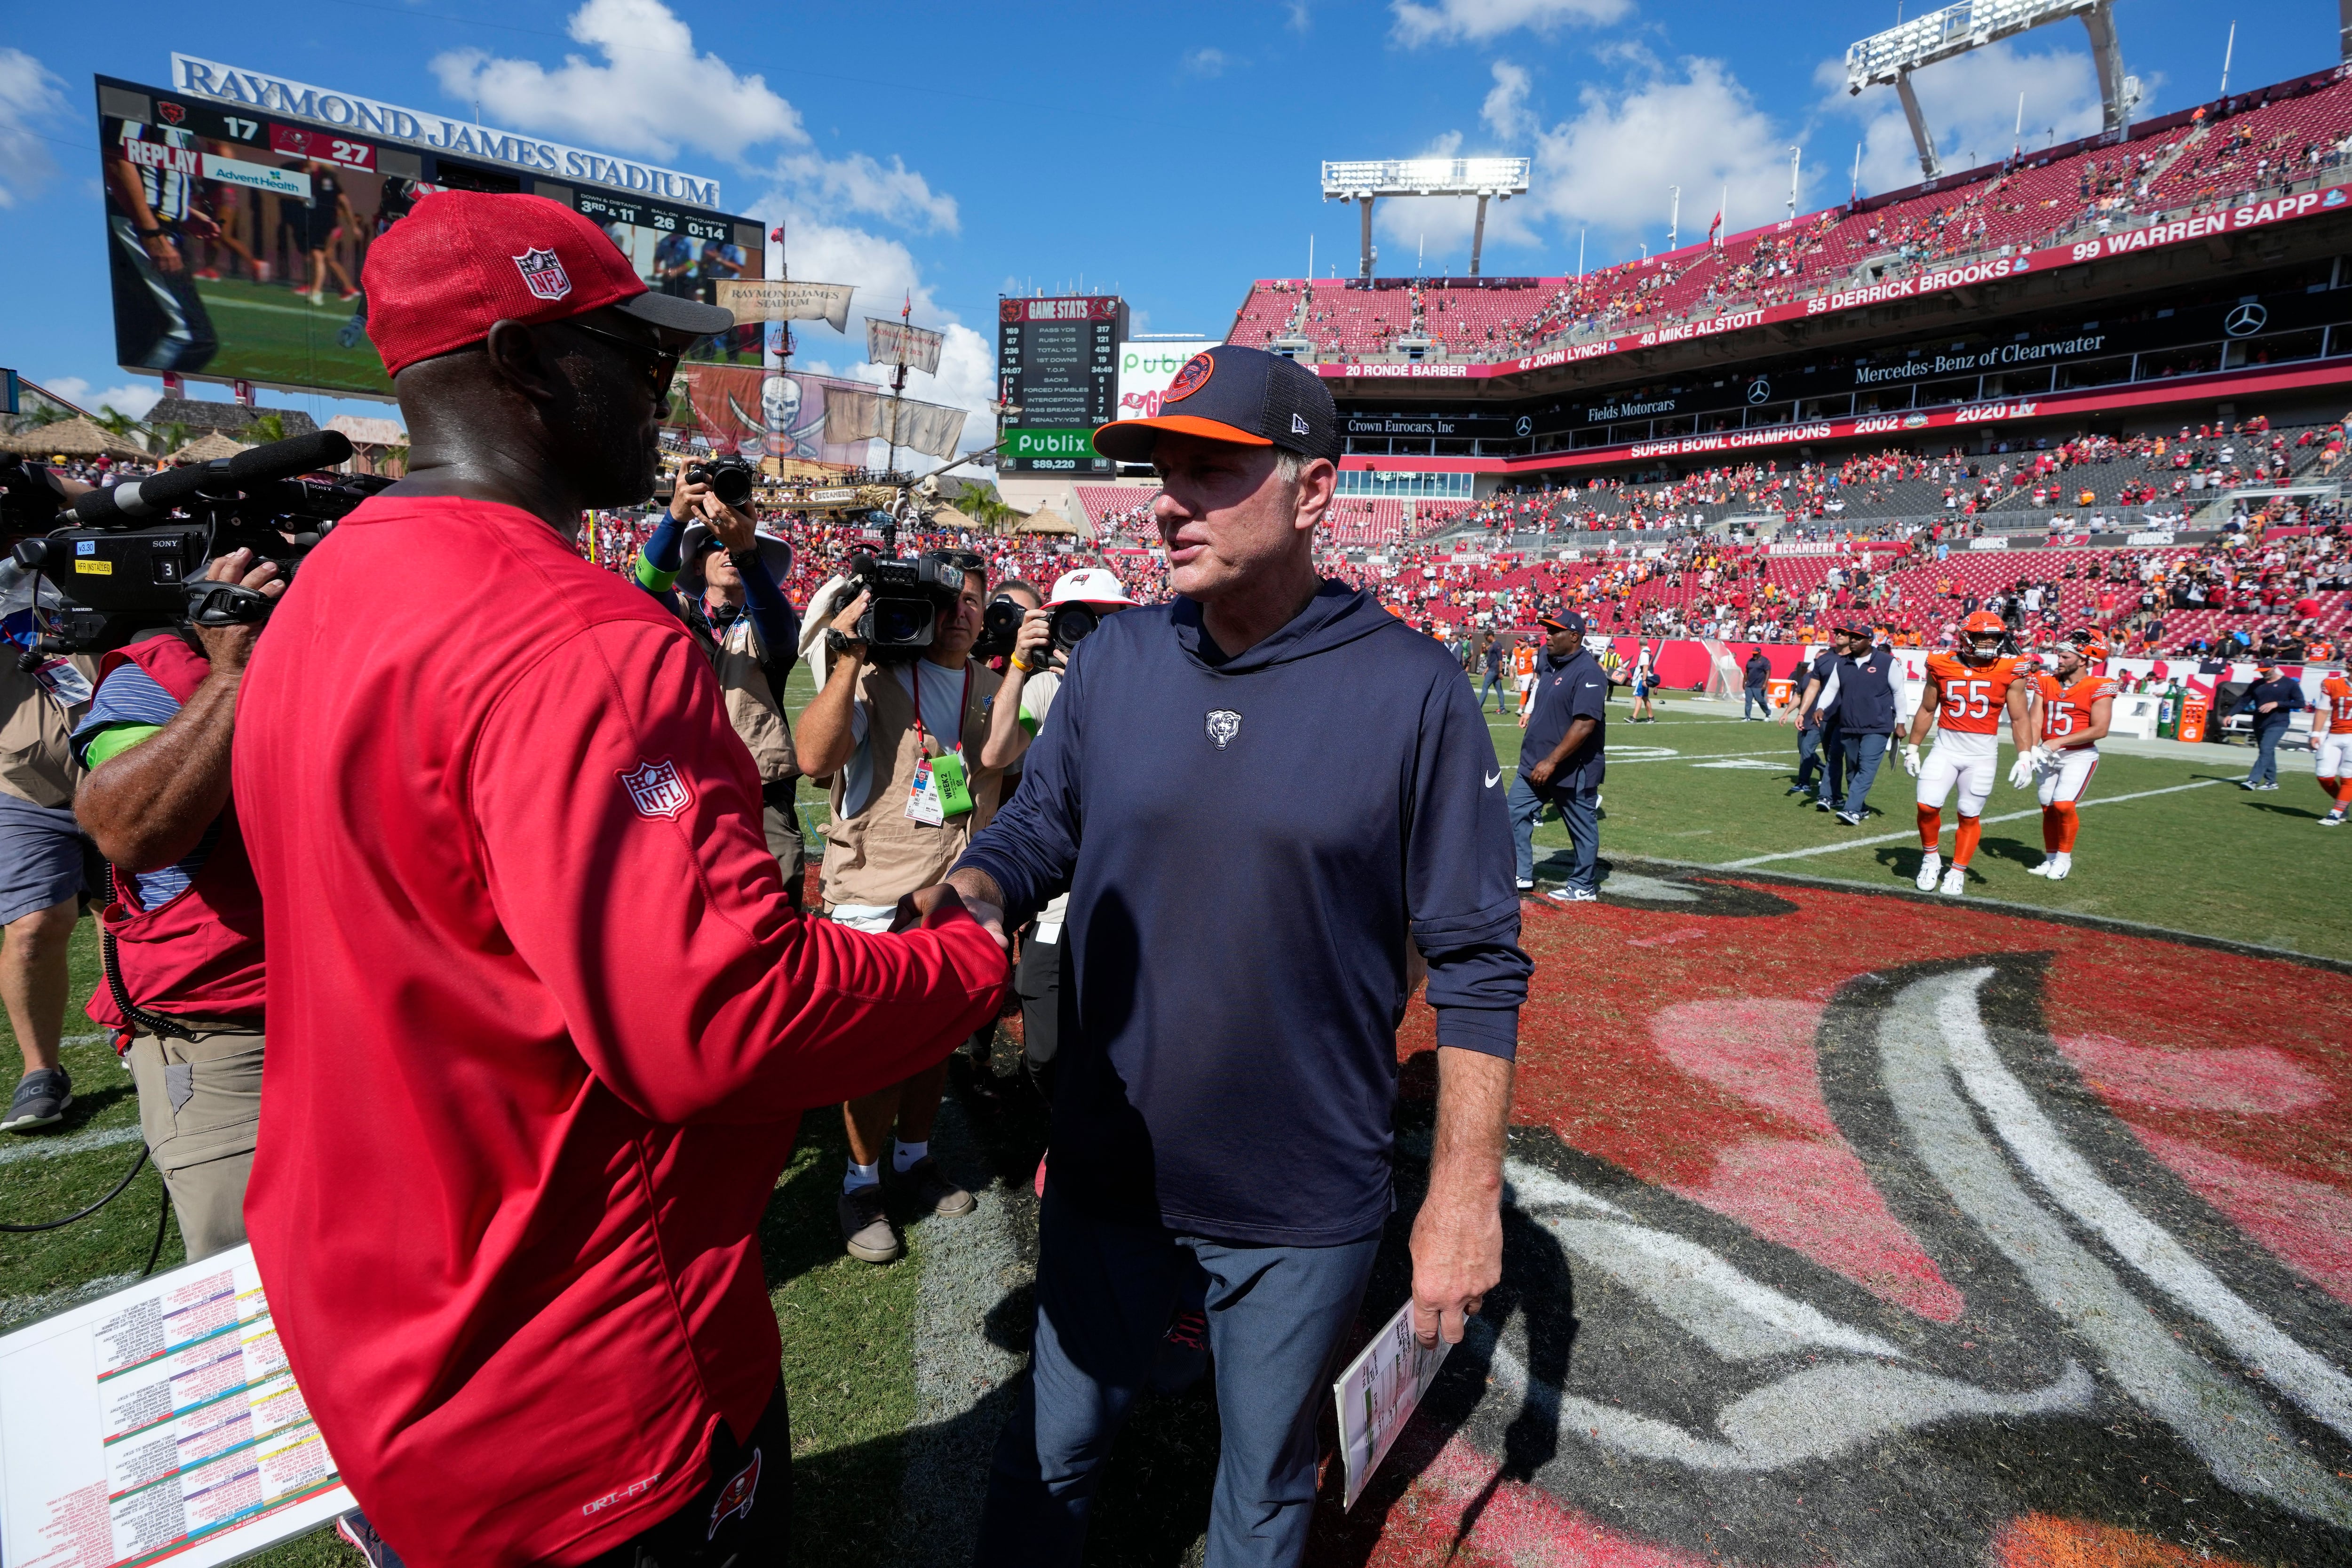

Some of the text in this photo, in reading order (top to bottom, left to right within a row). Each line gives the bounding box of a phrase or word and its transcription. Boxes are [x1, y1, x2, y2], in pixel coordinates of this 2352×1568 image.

[179, 59, 718, 206] RAYMOND JAMES STADIUM
[224, 117, 258, 141] 17
[127, 141, 197, 174] REPLAY
[332, 140, 369, 164] 27
[216, 168, 299, 193] AdventHealth
[580, 193, 602, 202] DOWN
[609, 199, 642, 210] DISTANCE
[581, 201, 606, 213] 3RD
[620, 208, 635, 222] 11
[654, 215, 675, 230] 26
[698, 218, 727, 228] QUARTER
[1778, 220, 1792, 231] 340
[2073, 193, 2318, 261] 99 WARREN SAPP
[688, 223, 724, 240] 0:14
[532, 269, 565, 293] NFL
[1807, 259, 2010, 314] 55 DERRICK BROOKS
[731, 289, 840, 300] RAYMOND JAMES
[756, 297, 810, 308] STADIUM
[1029, 300, 1088, 319] GAME STATS
[1640, 310, 1764, 345] 40 MIKE ALSTOTT
[1518, 342, 1608, 370] 47 JOHN LYNCH
[1855, 334, 2105, 384] Mercedes-Benz of Clearwater
[1192, 370, 1207, 386] LEAGUE
[1345, 364, 1466, 377] 20 RONDÉ BARBER
[1588, 399, 1675, 422] Fields Motorcars
[1348, 419, 1454, 434] Crown Eurocars, Inc
[1631, 440, 1678, 458] SUPER
[1682, 436, 1727, 452] BOWL
[1730, 422, 1831, 447] CHAMPIONS
[1854, 415, 1899, 434] 2002
[1955, 402, 2006, 423] 2020
[1019, 435, 1085, 451] Publix
[1033, 460, 1075, 470] $89,220
[1969, 537, 2008, 549] #GOBUCS
[2127, 532, 2175, 545] #GOBUCS
[79, 543, 93, 552] v3.30
[87, 562, 110, 573] INSTALLED
[165, 564, 172, 576] 3
[2311, 647, 2325, 657] 52
[1519, 657, 1525, 669] 8
[1946, 680, 1991, 718] 55
[2047, 700, 2074, 736] 15
[2184, 729, 2196, 739] G
[639, 783, 682, 810] NFL
[941, 780, 953, 799] WEEK
[288, 1441, 302, 1449] PENNY
[280, 1485, 293, 1494] STUFF
[282, 1486, 303, 1498] COVERAGE
[271, 1499, 296, 1514] DEFENSIVE
[242, 1516, 257, 1526] SHEET
[258, 1511, 270, 1519] CALL
[212, 1526, 233, 1538] CHICAGO
[194, 1535, 210, 1545] BEARS
